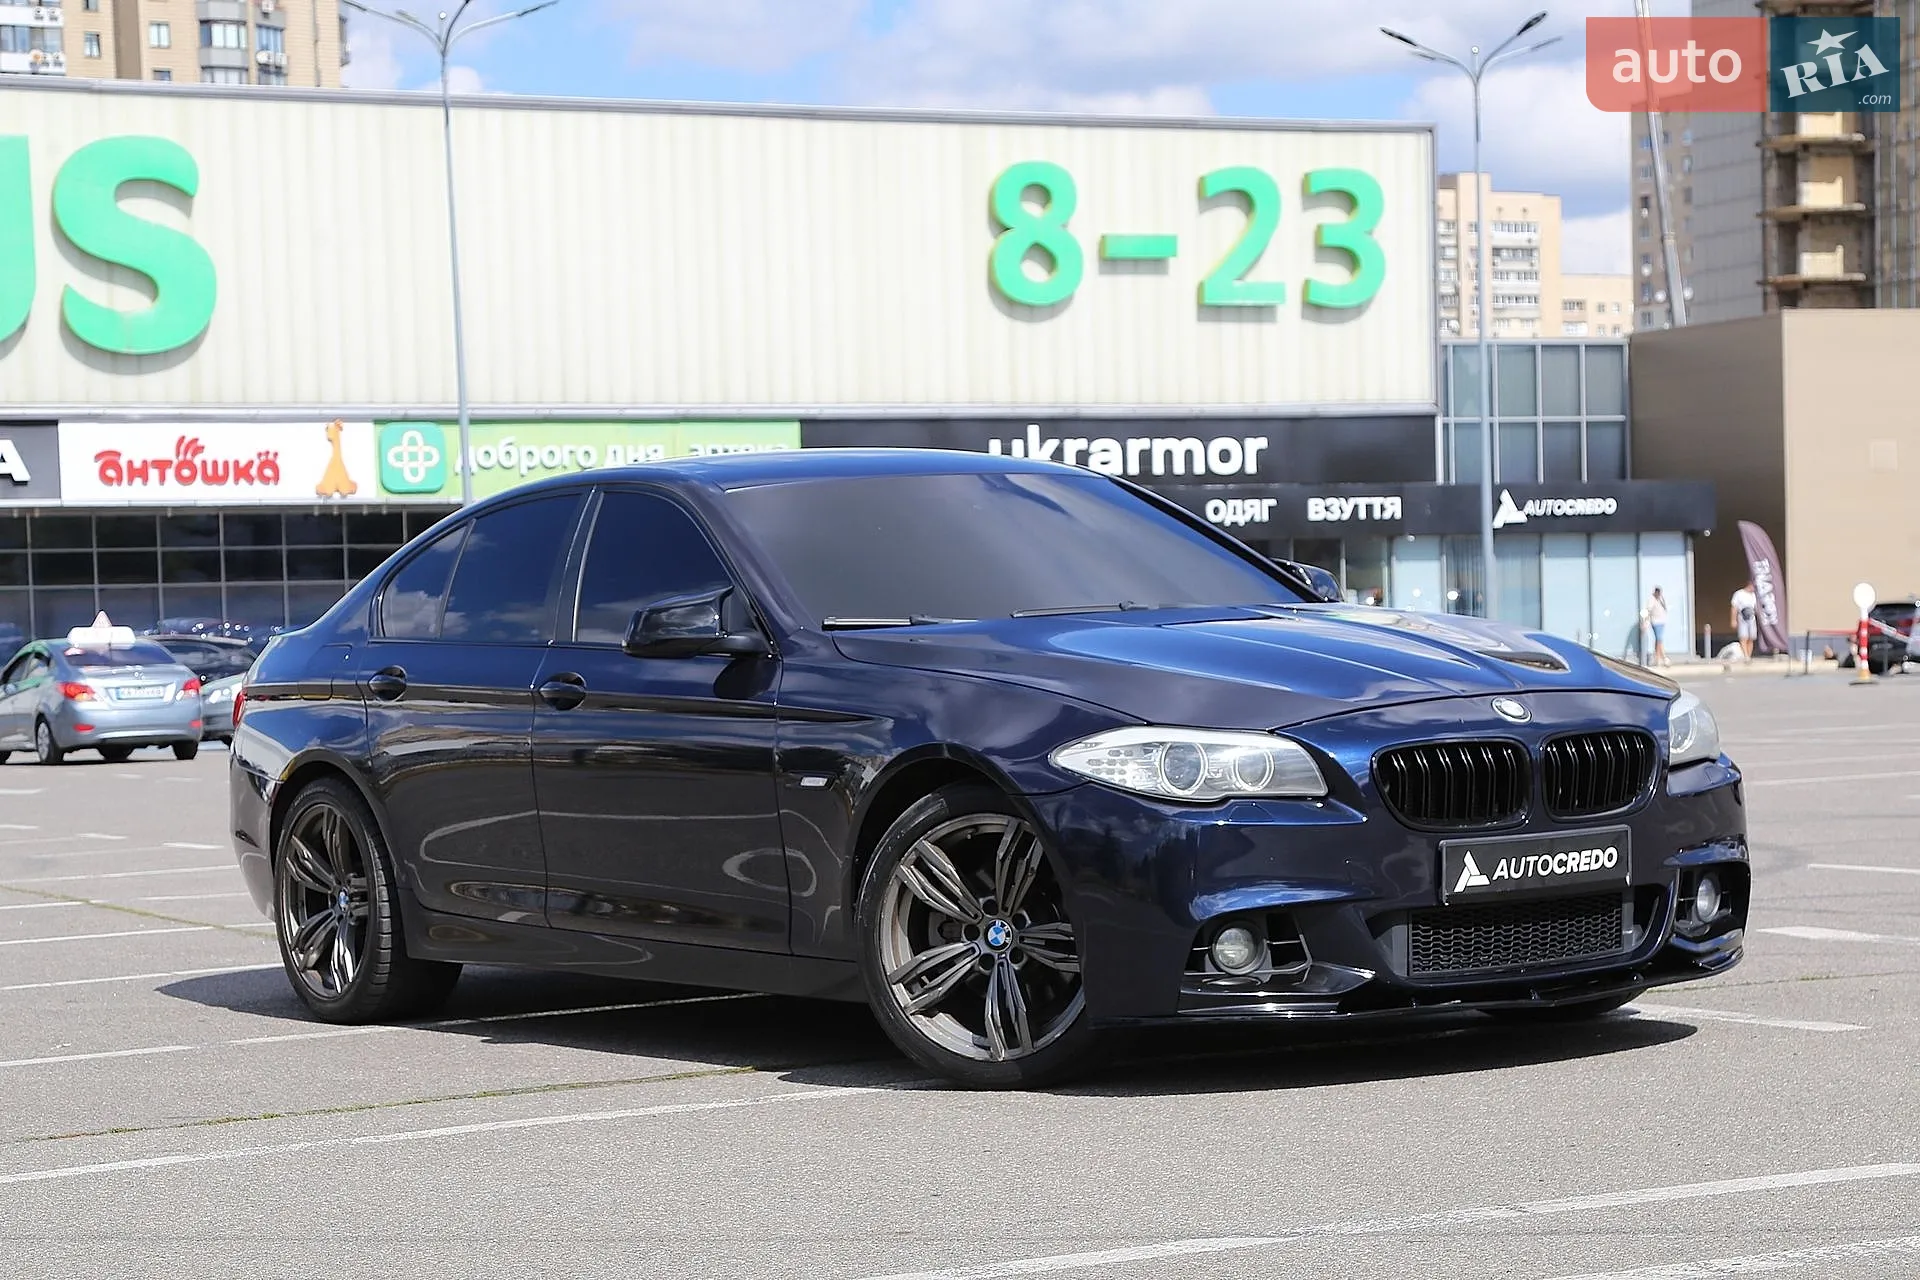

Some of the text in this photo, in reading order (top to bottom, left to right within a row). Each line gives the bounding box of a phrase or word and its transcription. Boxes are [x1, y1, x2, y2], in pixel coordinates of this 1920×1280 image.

[1205, 496, 1402, 527] ОДЯГ ВЗУТТЯ
[1522, 497, 1618, 516] AUTOCREDO
[1492, 846, 1618, 881] AUTOCREDO
